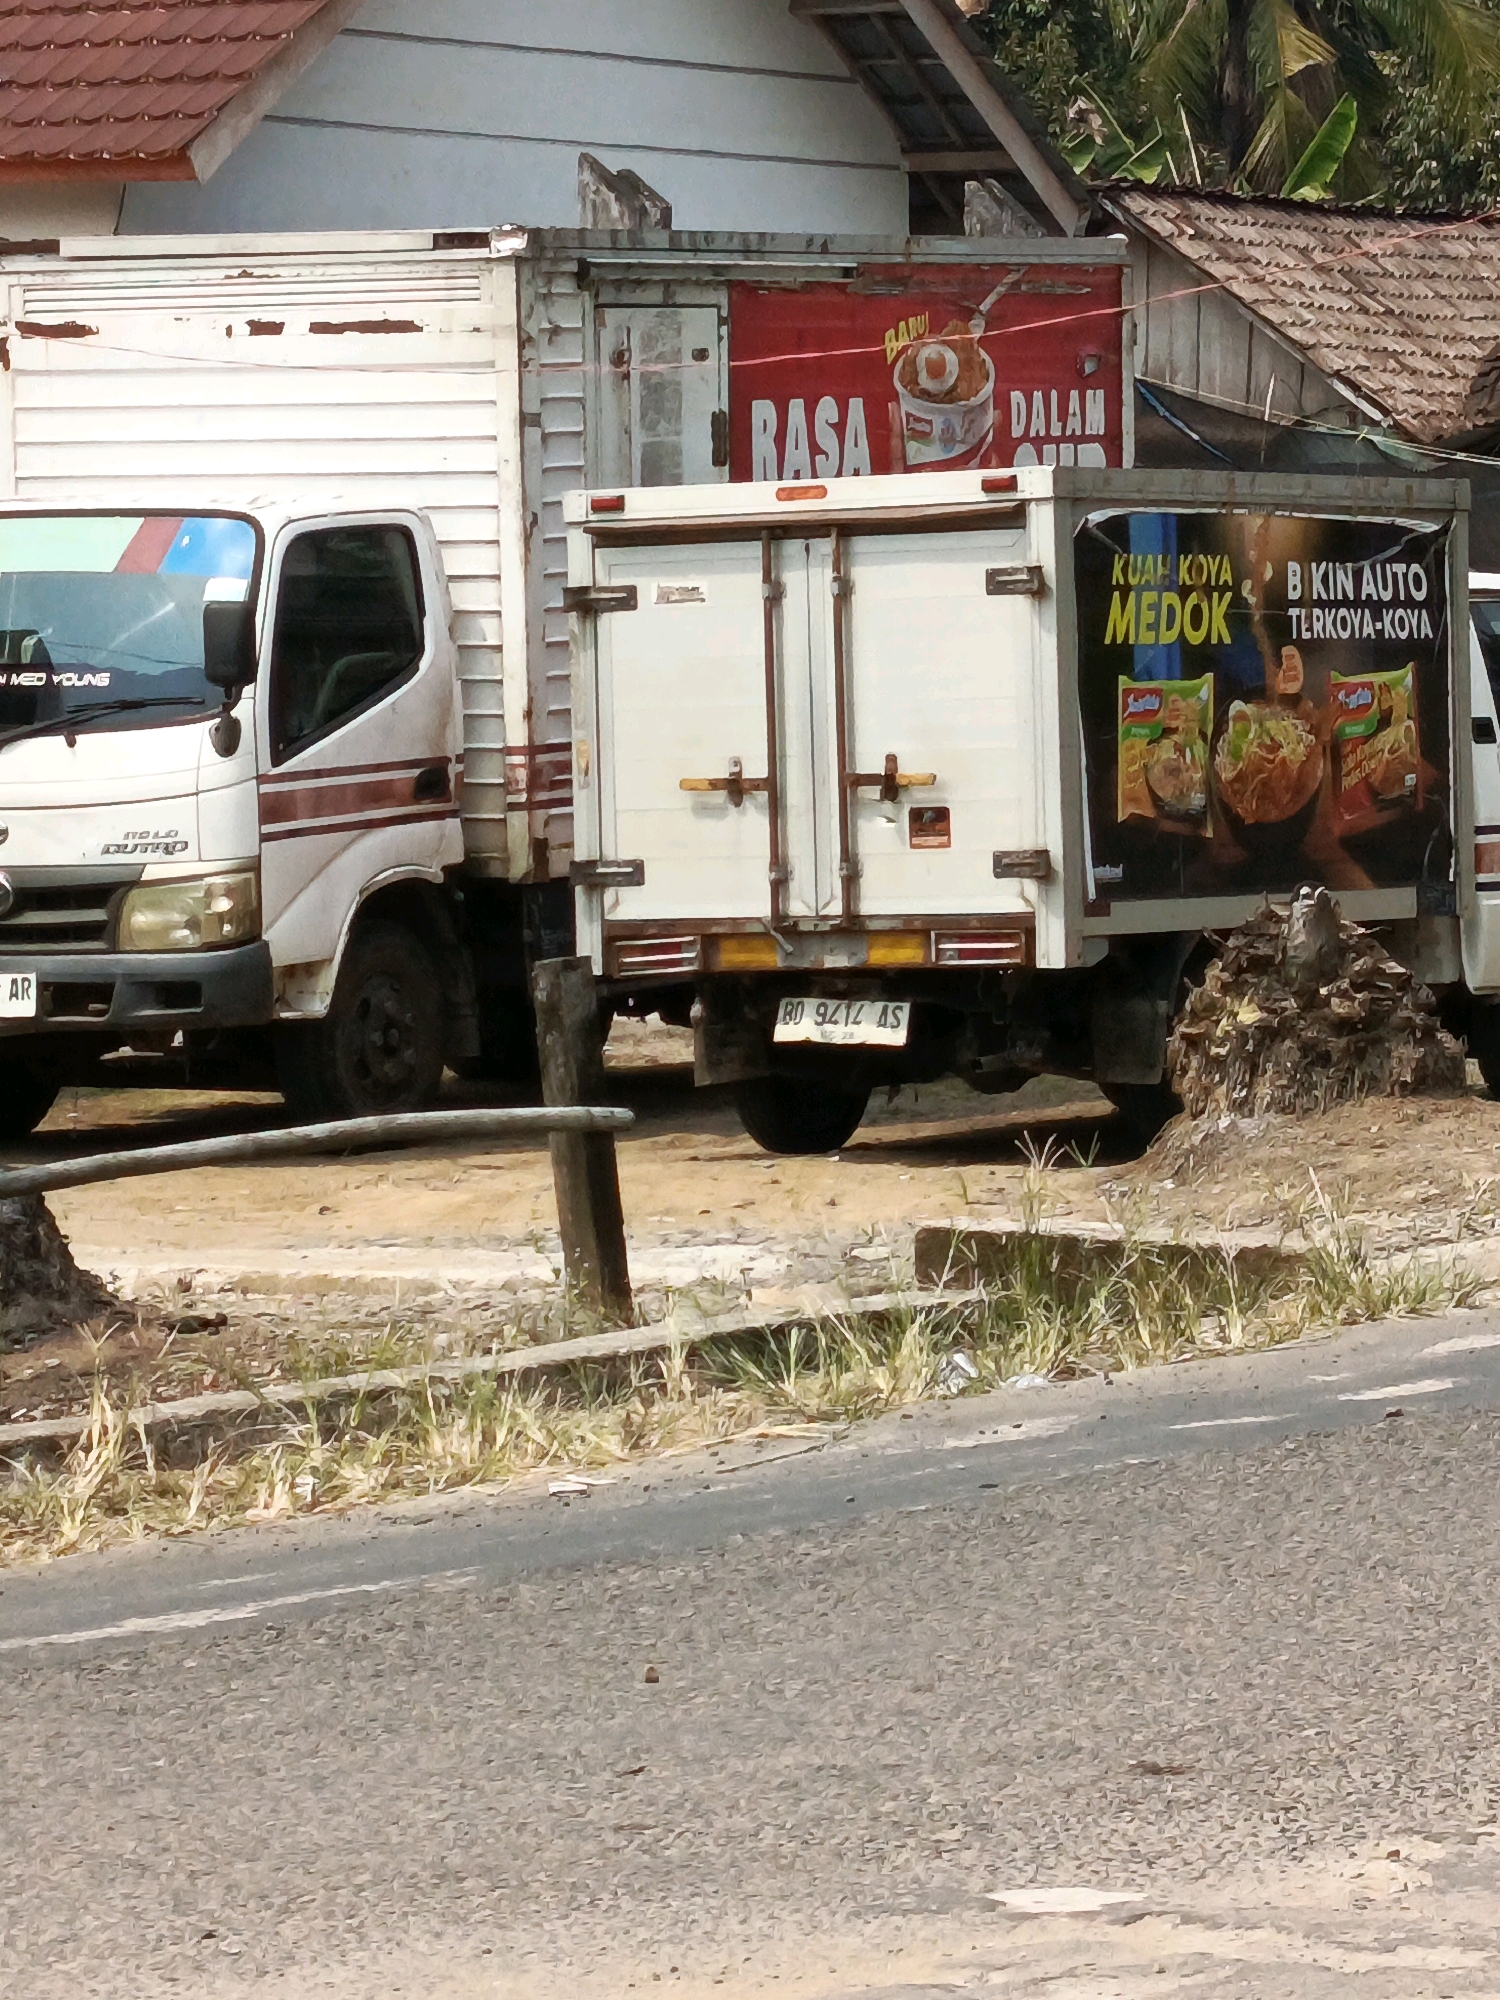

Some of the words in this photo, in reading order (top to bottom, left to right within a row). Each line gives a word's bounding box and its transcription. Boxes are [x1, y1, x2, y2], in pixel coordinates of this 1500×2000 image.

[1010, 388, 1105, 438] DALAM
[752, 396, 871, 482] RASA
[1179, 554, 1232, 586] KOYA
[1361, 562, 1427, 601] AUTO
[1104, 591, 1233, 645] MEDOK
[1287, 607, 1433, 640] TERKOYA-KOYA
[52, 672, 110, 687] YOUNG
[9, 976, 32, 1001] AR
